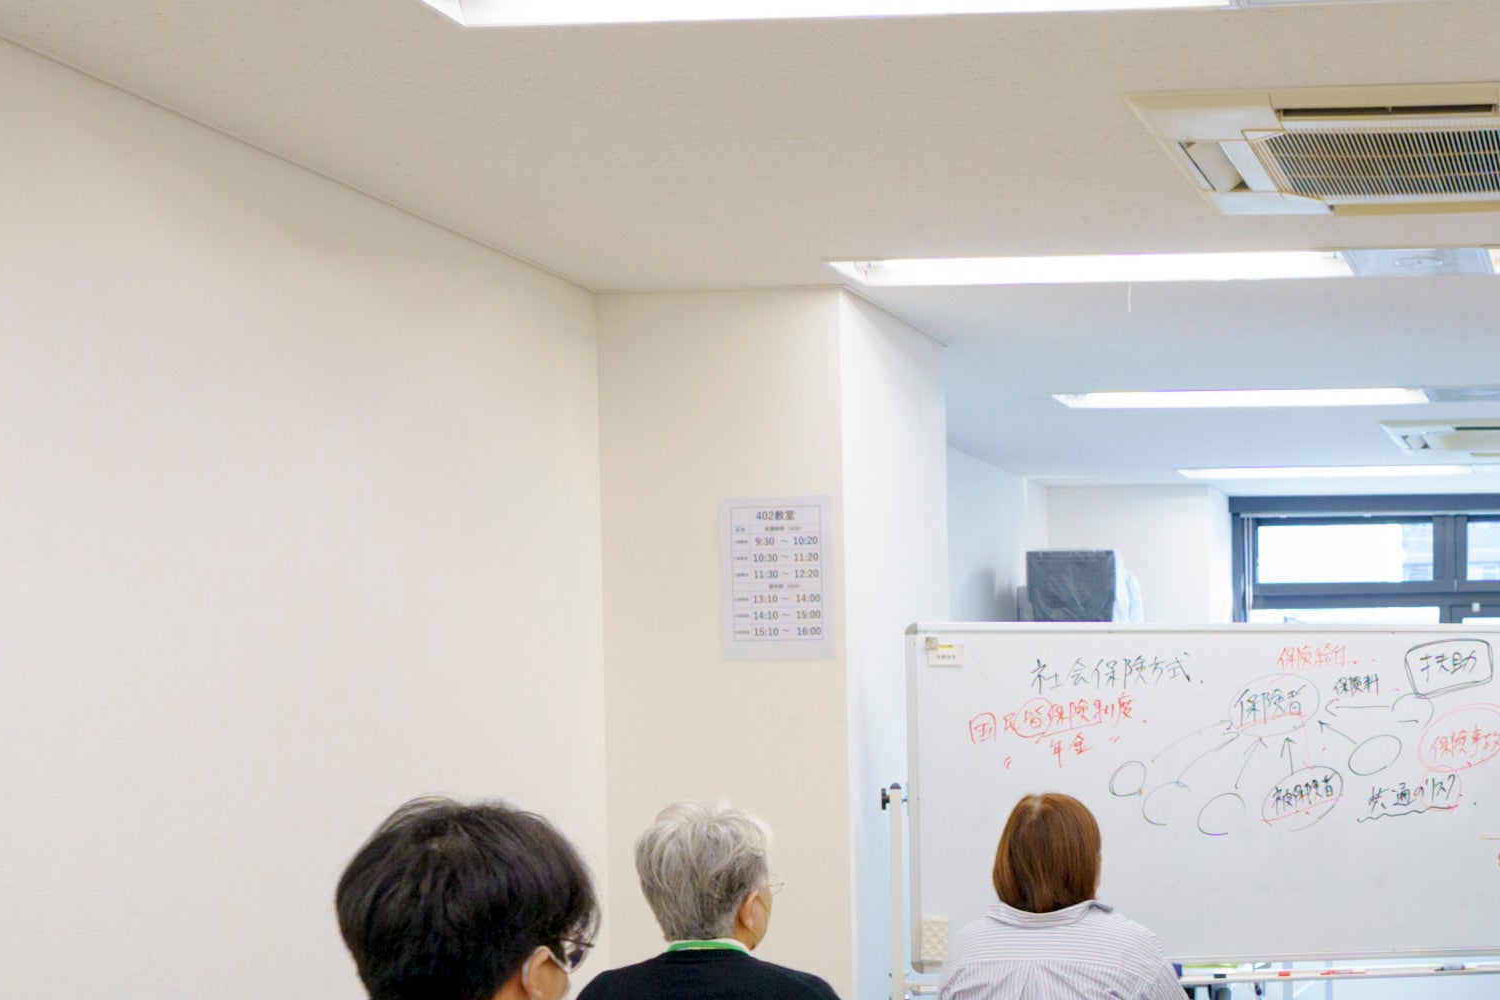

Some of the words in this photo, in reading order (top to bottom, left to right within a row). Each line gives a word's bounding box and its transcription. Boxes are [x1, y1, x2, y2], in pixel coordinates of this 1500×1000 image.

[1030, 651, 1191, 694] 社会保険方式
[1419, 650, 1477, 682] 扶助
[1332, 673, 1379, 697] 保険料
[1233, 683, 1308, 727] 保険者
[1049, 732, 1095, 768] 年金
